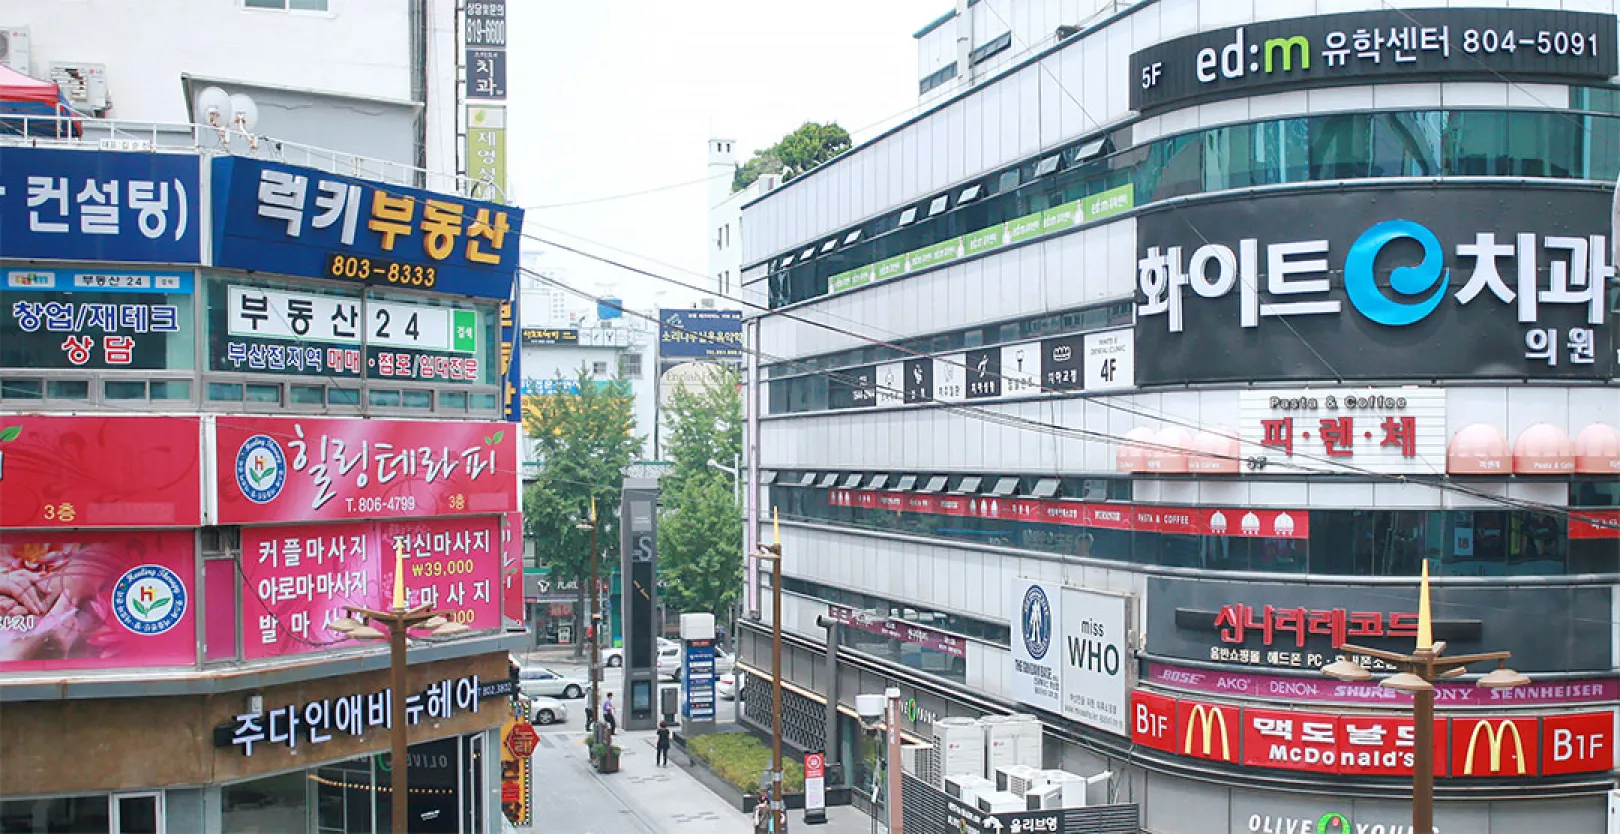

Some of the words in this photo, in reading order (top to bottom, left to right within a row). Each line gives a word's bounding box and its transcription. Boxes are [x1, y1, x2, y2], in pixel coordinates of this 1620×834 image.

[1196, 27, 1311, 83] ed:m
[1321, 25, 1451, 66] 유학센터
[1463, 29, 1598, 57] 804-5091
[1142, 62, 1161, 89] 5F
[26, 176, 188, 241] 컨설팅)
[331, 255, 437, 288] 803-8333
[1138, 237, 1342, 333] 화이트
[1455, 233, 1614, 325] 치과
[12, 299, 181, 334] 창업/재테크
[240, 293, 358, 338] 부동산
[375, 308, 420, 341] 24
[61, 335, 135, 365] 상담
[227, 341, 322, 372] 부산전지역
[1525, 327, 1597, 367] 의원
[1100, 358, 1117, 382] 4F
[1270, 395, 1318, 410] Pasta
[1325, 395, 1339, 409] &
[1344, 395, 1408, 410] Coffee
[288, 424, 497, 510] 힐링테라피
[44, 502, 77, 522] 3층
[1081, 618, 1105, 637] miss
[1213, 602, 1420, 649] 신나라레코드
[1067, 635, 1120, 676] WHO
[1210, 645, 1261, 664] 음반쇼핑몰
[1307, 653, 1323, 667] PC
[1159, 668, 1204, 685] BOSE
[1216, 676, 1250, 691] AKG
[1269, 681, 1320, 696] DENON
[1334, 685, 1397, 698] SHURE
[1411, 687, 1474, 700] ONY
[1490, 683, 1604, 700] SENNHEISER
[1136, 704, 1168, 739] B1F
[1268, 744, 1415, 767] McDonald's
[1553, 727, 1604, 762] B1F
[1010, 816, 1058, 834] 올리브영
